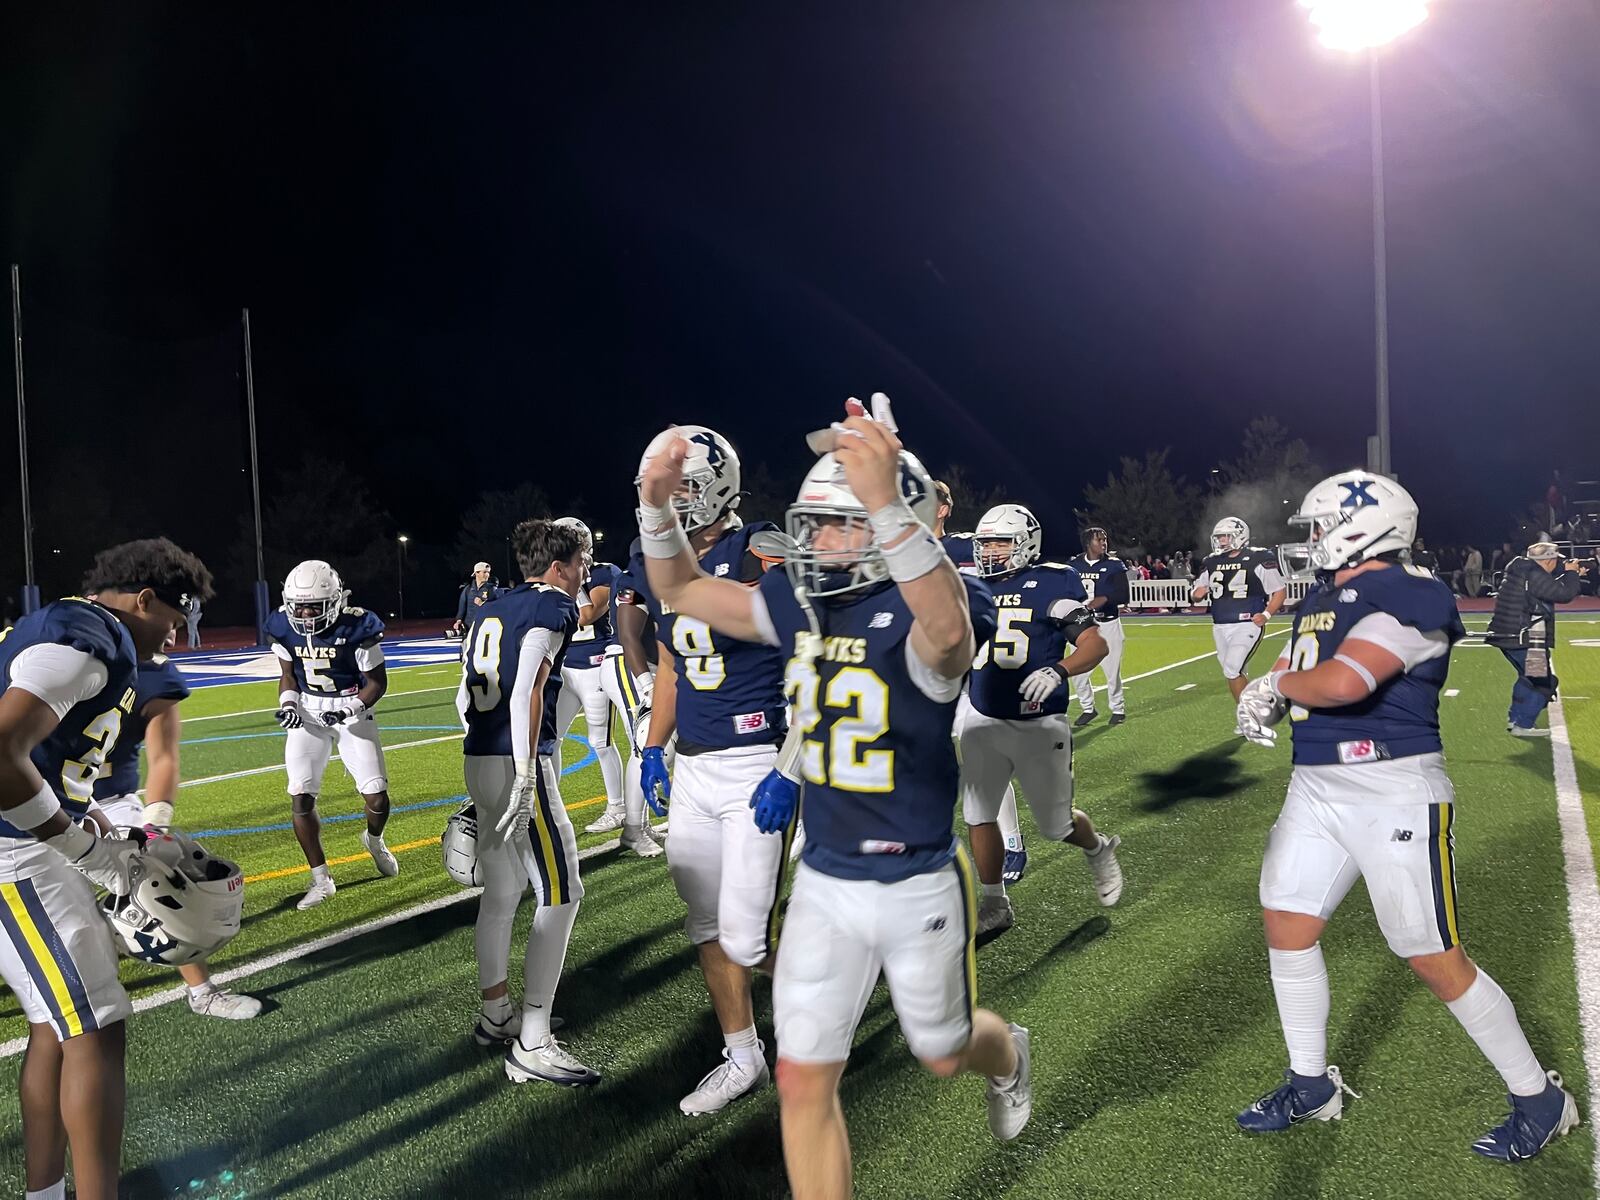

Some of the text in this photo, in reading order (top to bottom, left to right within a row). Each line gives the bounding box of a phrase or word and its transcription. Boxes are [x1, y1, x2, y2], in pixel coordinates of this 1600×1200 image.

[1338, 480, 1379, 507] X
[1216, 563, 1242, 571] HAWKS
[1209, 569, 1249, 599] 64
[992, 593, 1022, 606] WKS
[294, 646, 337, 659] HAWKS
[671, 614, 728, 691] 8
[972, 607, 1034, 669] 5
[301, 657, 338, 693] 5
[784, 665, 895, 793] 22
